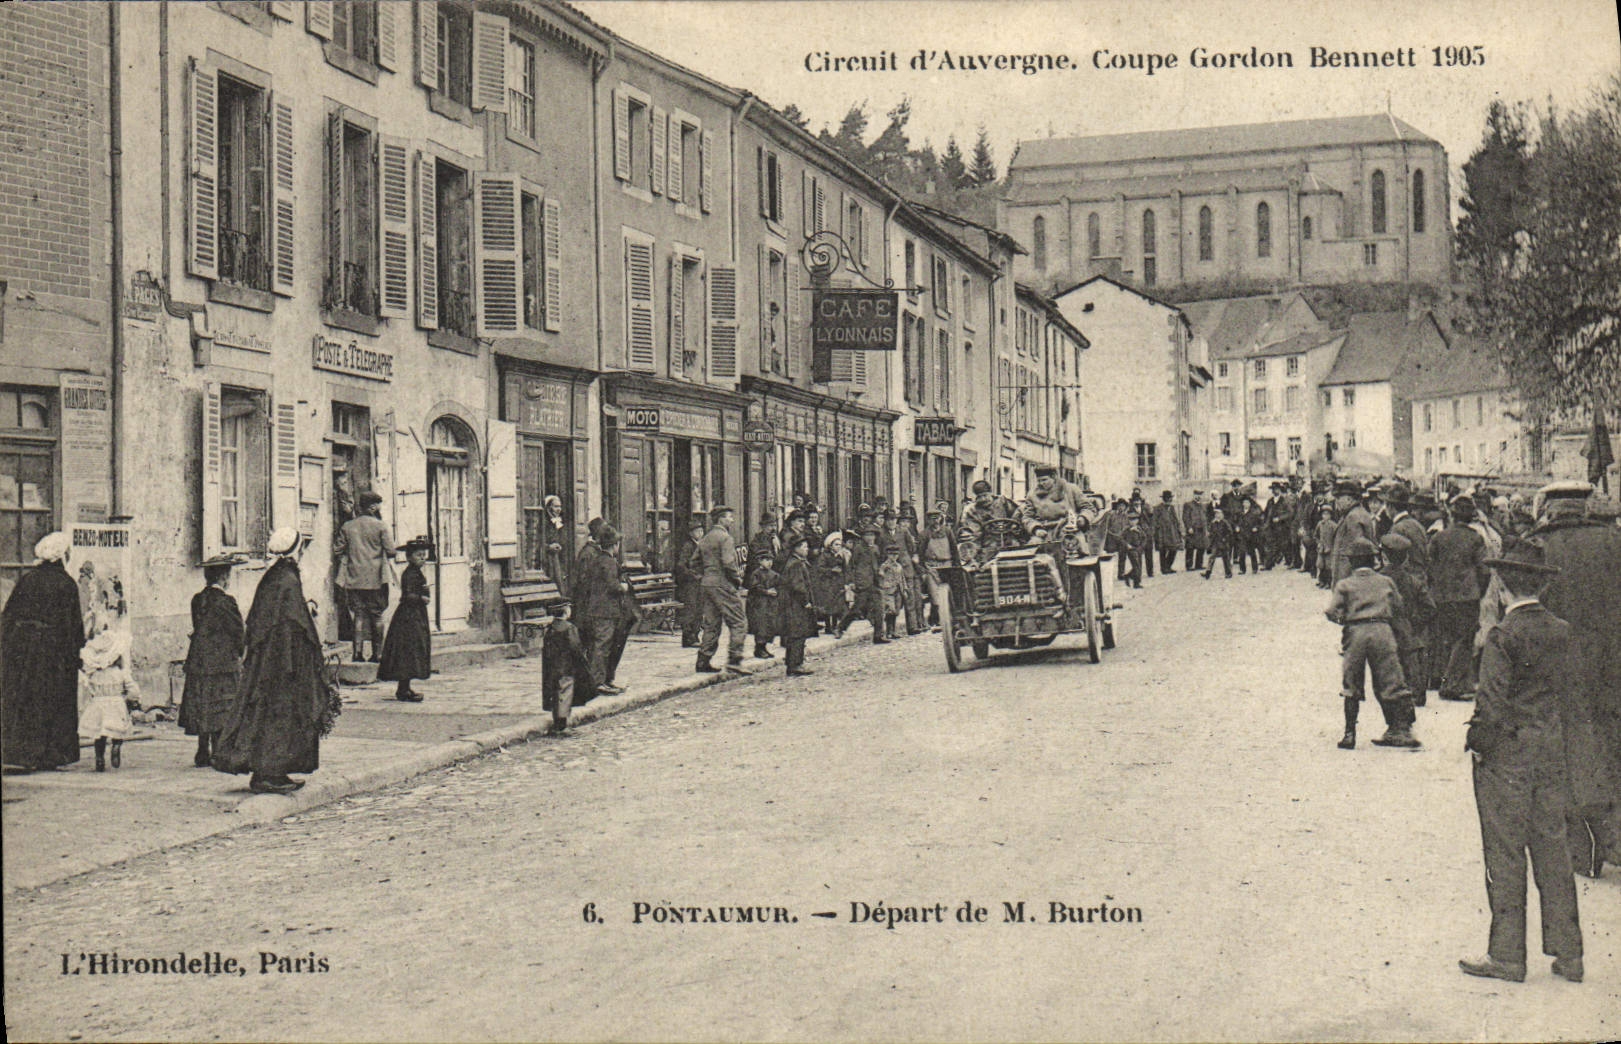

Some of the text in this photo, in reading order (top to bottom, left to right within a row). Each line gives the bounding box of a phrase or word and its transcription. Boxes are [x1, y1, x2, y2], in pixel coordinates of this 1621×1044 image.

[816, 326, 894, 343] LYONNAIS
[626, 410, 658, 425] MOTO
[915, 422, 954, 442] TABAC
[72, 528, 130, 548] BENZO-MOTEUR
